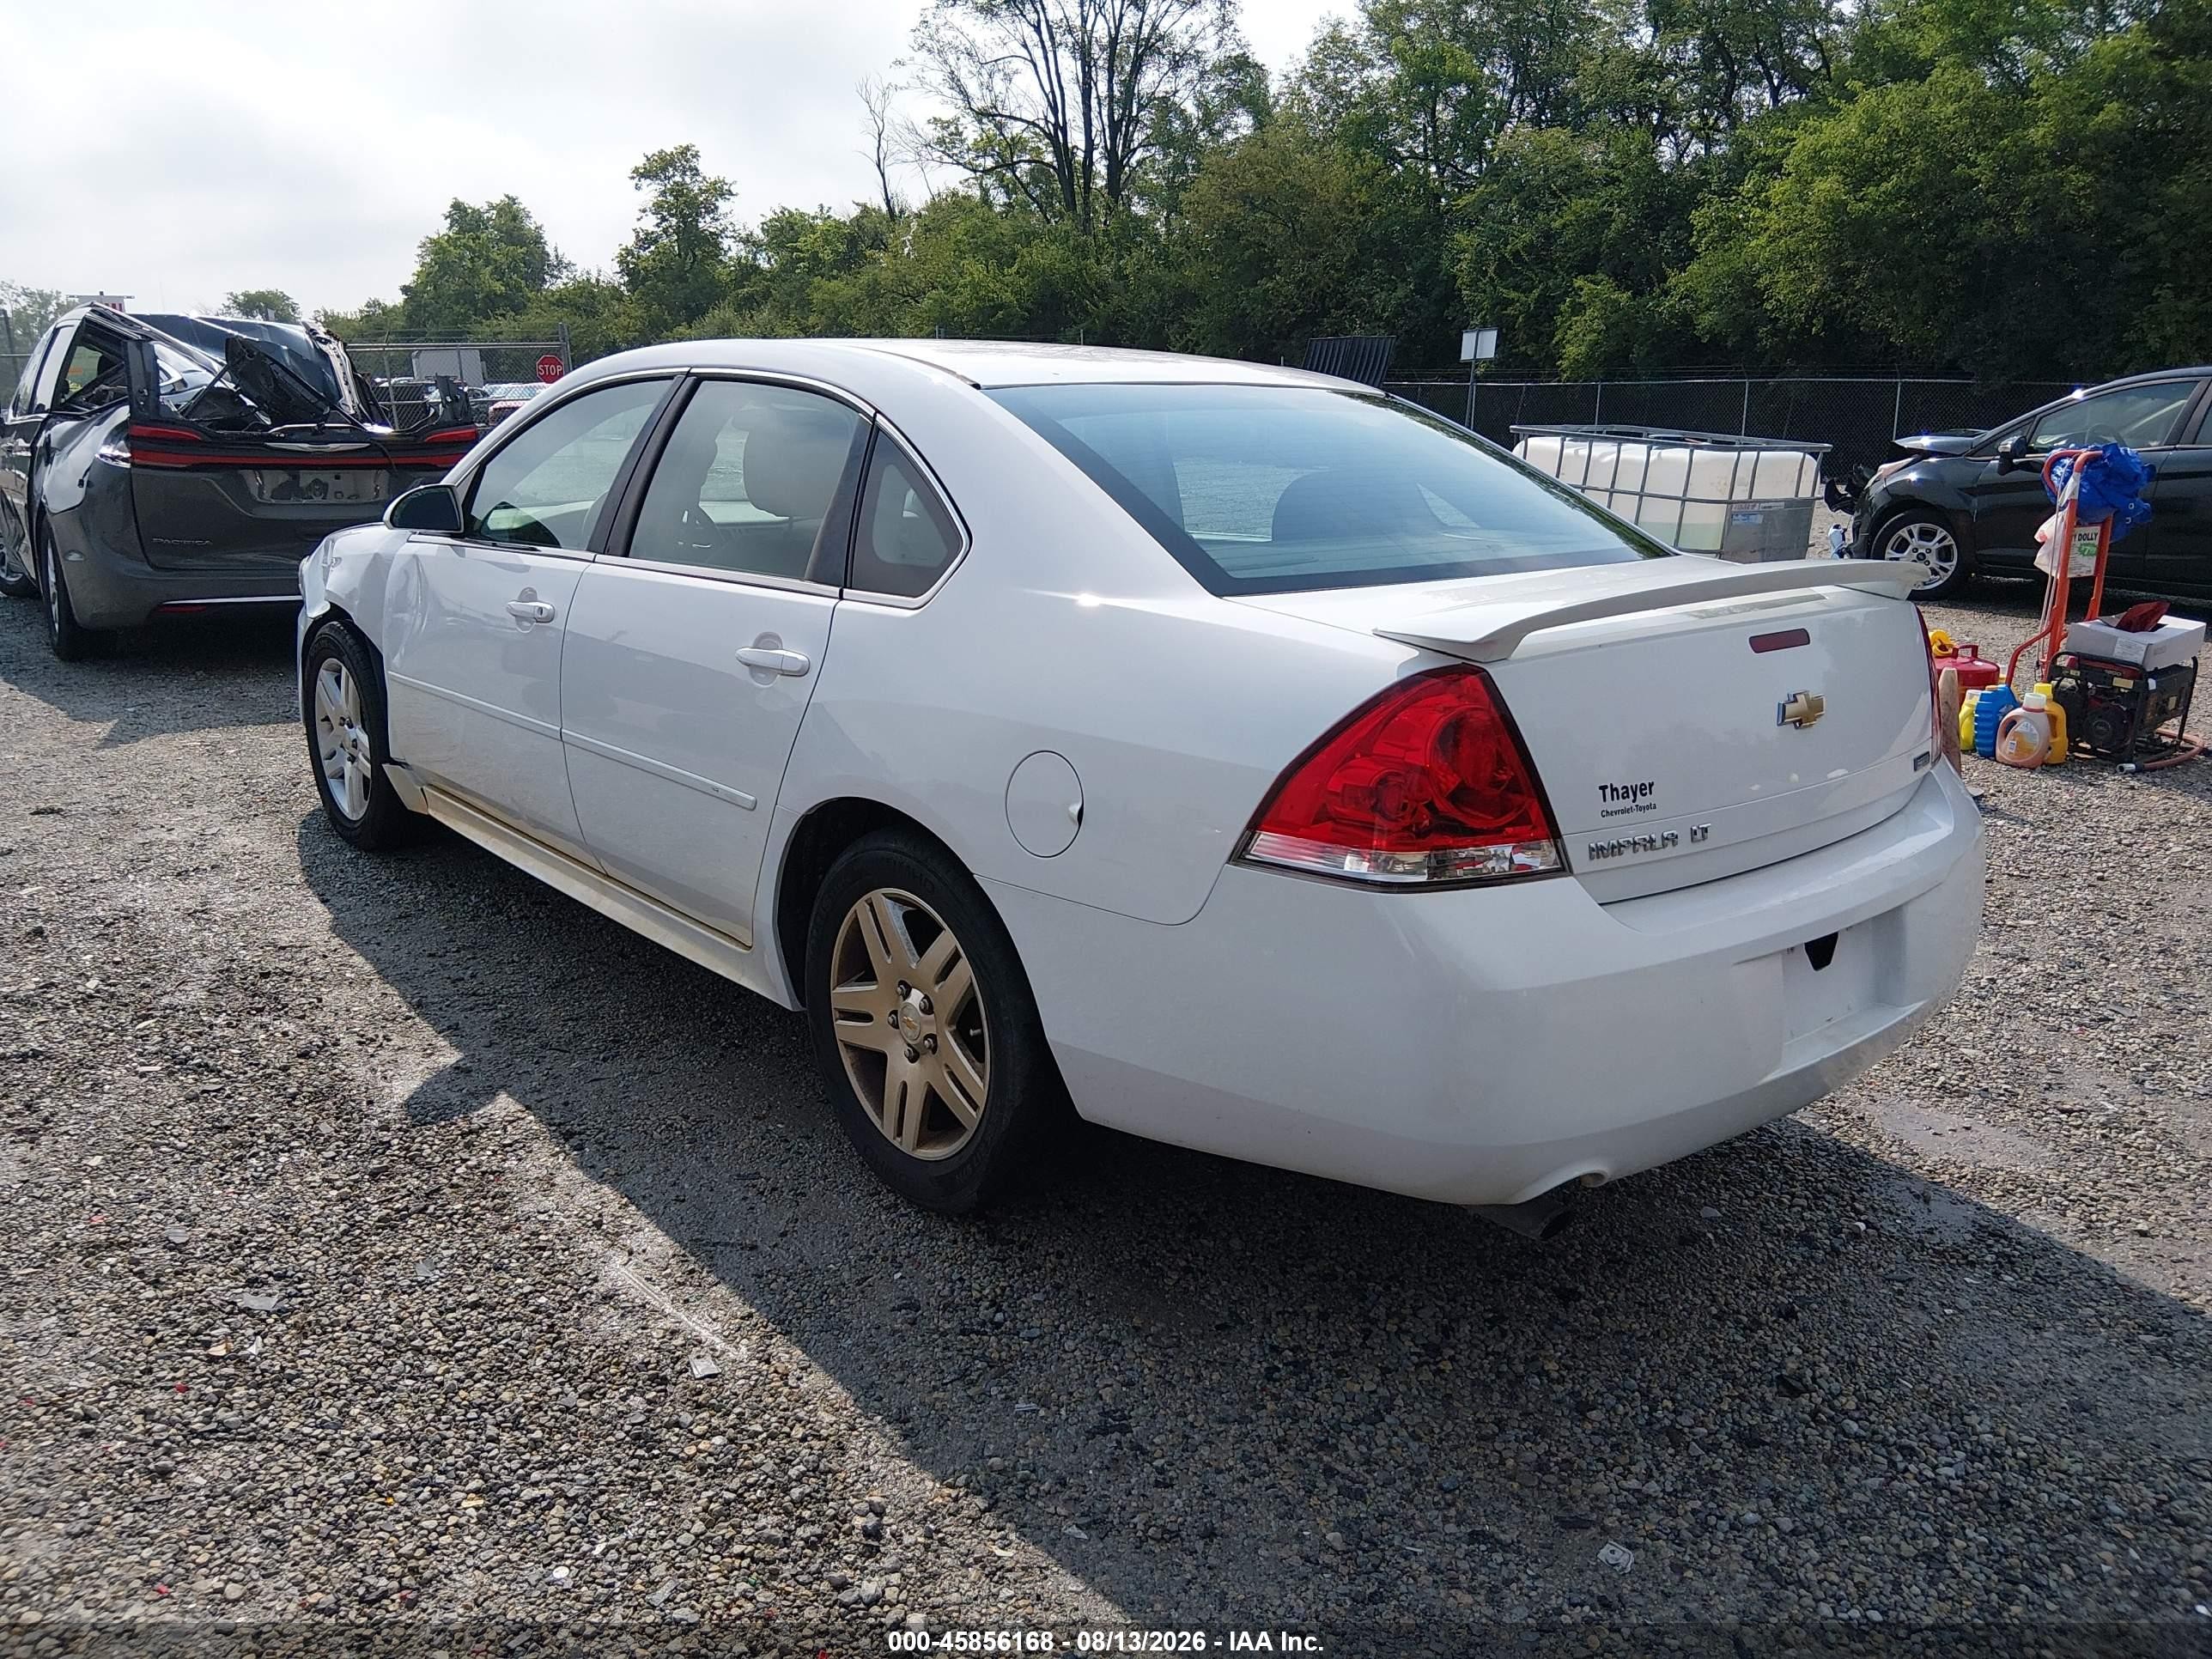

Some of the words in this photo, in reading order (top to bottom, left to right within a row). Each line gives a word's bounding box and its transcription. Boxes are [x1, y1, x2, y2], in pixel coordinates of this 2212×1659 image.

[538, 364, 562, 376] STOP
[2078, 532, 2099, 542] DOLLY
[1598, 781, 1655, 804] Thayer
[1589, 830, 1679, 861] IMPALA
[1690, 823, 1711, 844] LT
